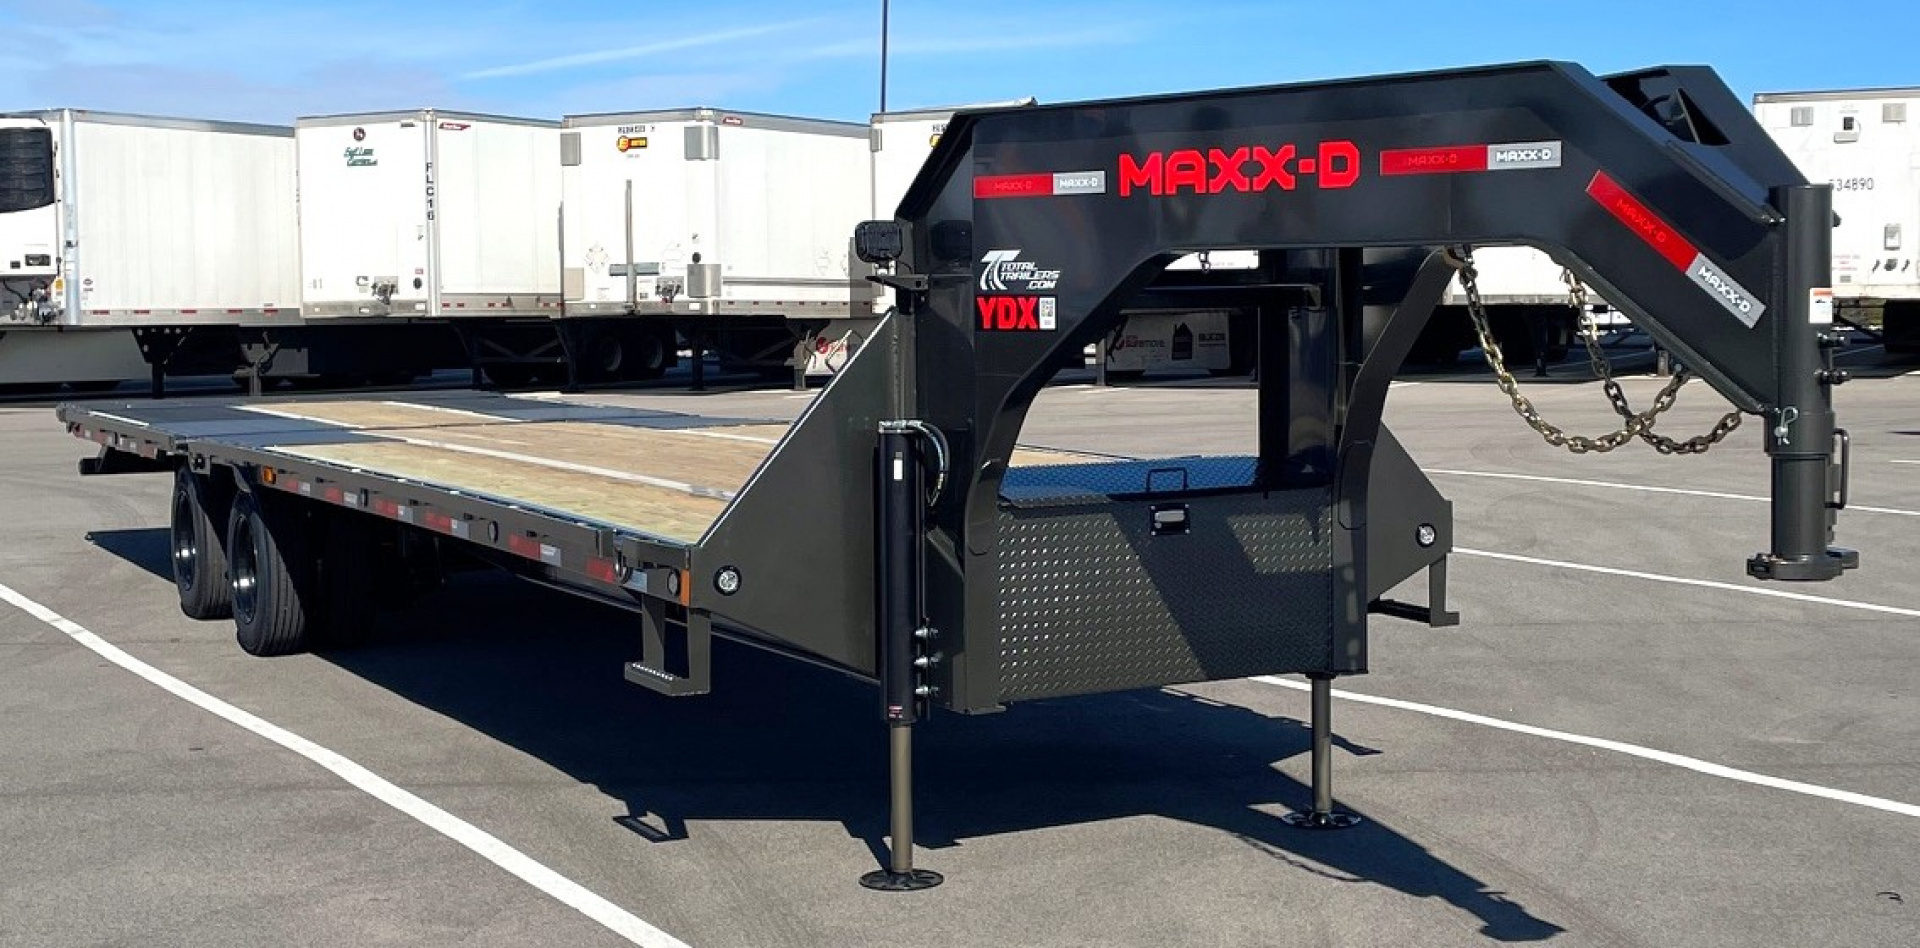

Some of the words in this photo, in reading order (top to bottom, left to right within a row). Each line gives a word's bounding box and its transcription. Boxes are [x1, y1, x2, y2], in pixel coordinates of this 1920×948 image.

[1496, 148, 1551, 162] MAXX-D
[1119, 141, 1360, 197] MAXX-D
[1059, 177, 1098, 188] MAXX-D
[1001, 262, 1038, 272] TOTAL
[1000, 270, 1061, 281] TRAILERS
[1026, 280, 1057, 290] .COM
[1698, 265, 1751, 313] MAXX-D
[976, 297, 1038, 329] YDX
